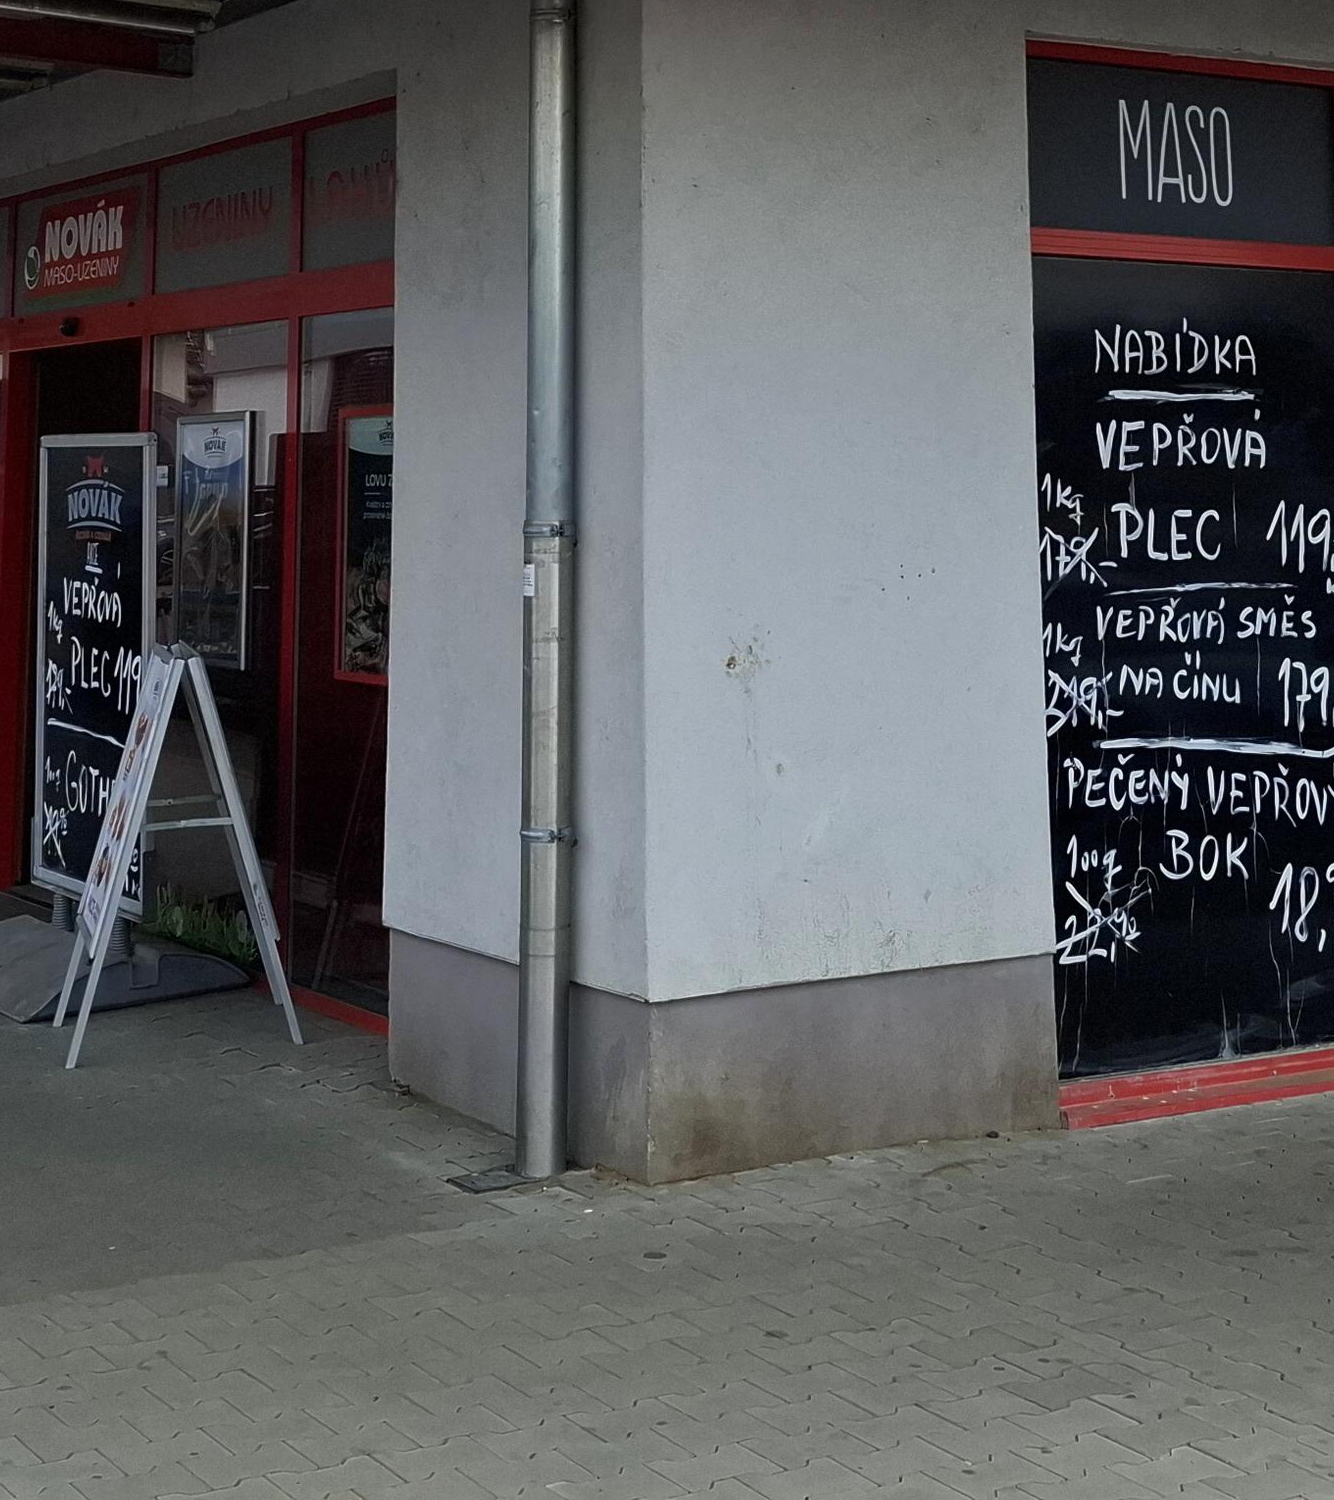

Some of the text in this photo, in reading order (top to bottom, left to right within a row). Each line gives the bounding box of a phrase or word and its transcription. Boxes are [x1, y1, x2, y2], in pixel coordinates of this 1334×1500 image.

[1118, 99, 1233, 207] MASO
[44, 199, 124, 264] NOVÁK
[43, 256, 121, 289] MASO-UZENINY
[1094, 317, 1257, 377] NABÍDKA
[1095, 408, 1267, 470] VEPŘOVÁ
[67, 480, 123, 525] NOVÁK
[1110, 502, 1222, 561] PLEC
[63, 561, 122, 628] VEPŘOVÁ
[1096, 594, 1317, 645] VEPŘOVÁ SMĚS
[70, 635, 112, 699] PLEC
[1119, 650, 1241, 704] NA ČÍNU
[1063, 753, 1190, 811] PEČENÝ
[1158, 829, 1250, 882] BOK
